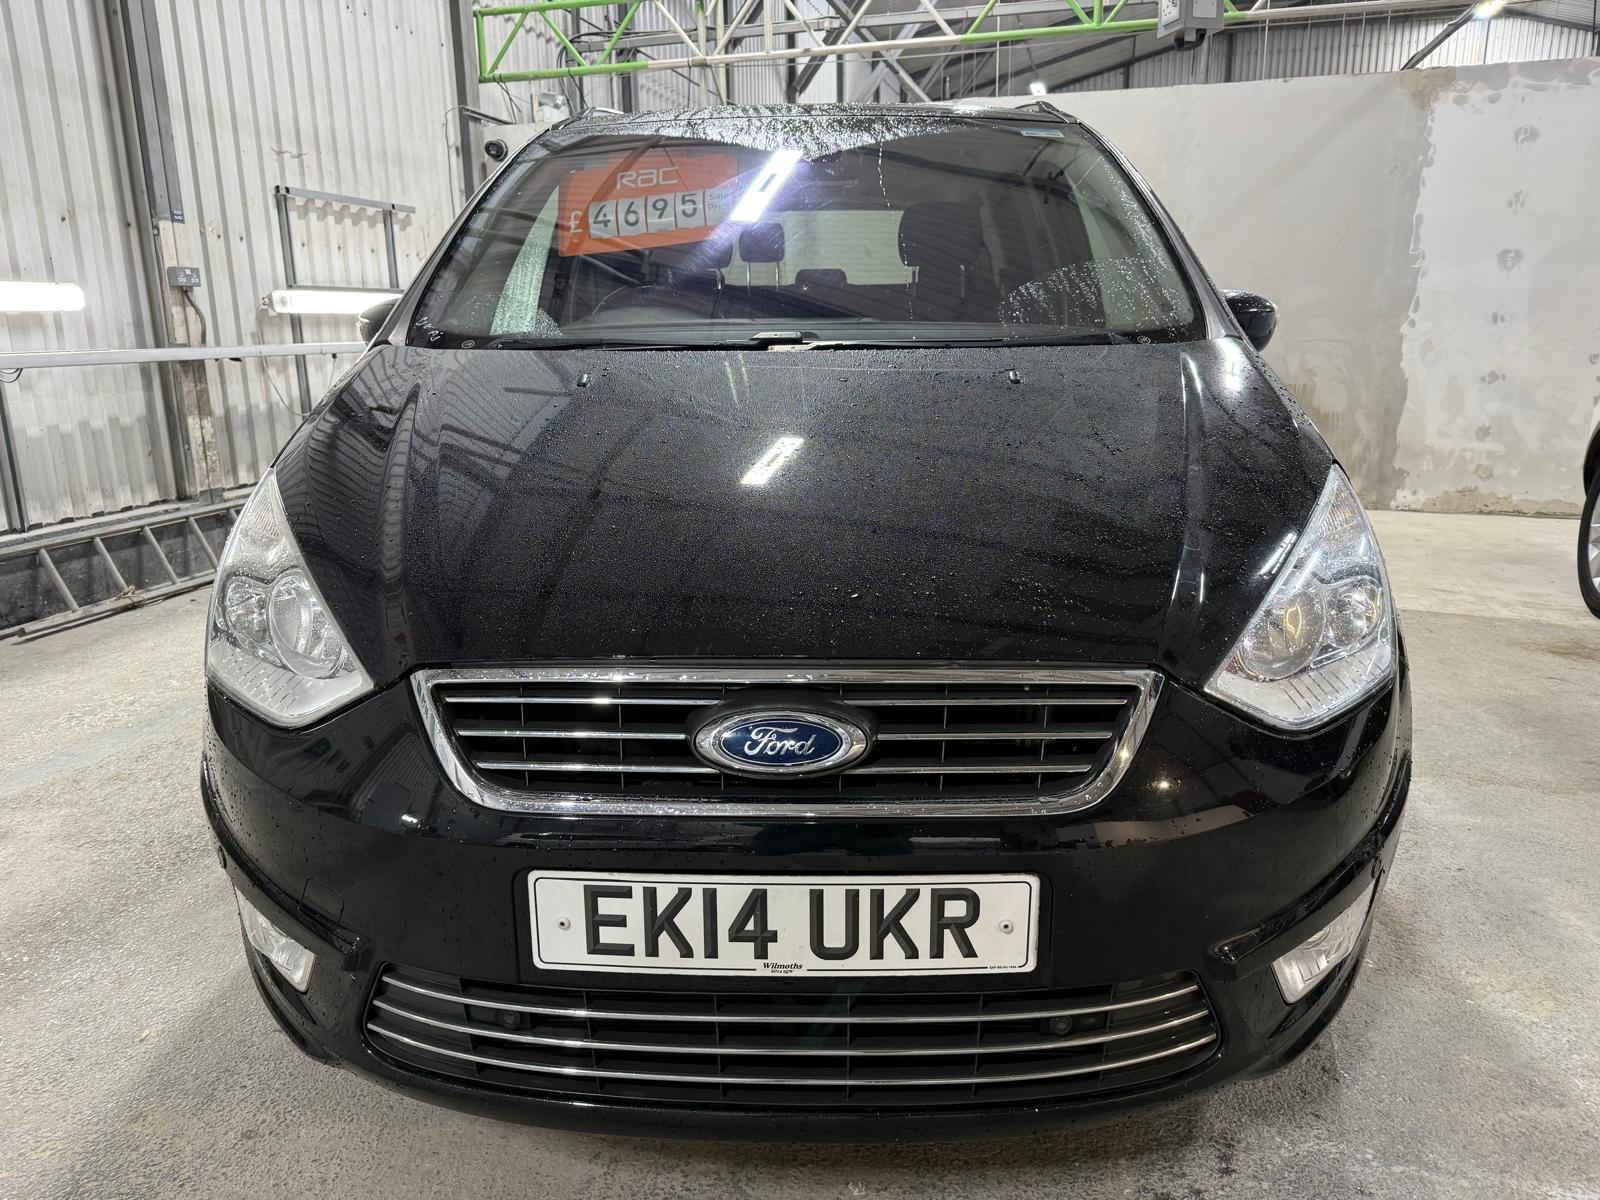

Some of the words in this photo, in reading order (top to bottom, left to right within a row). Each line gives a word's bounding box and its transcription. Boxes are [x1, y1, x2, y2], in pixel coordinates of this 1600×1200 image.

[743, 726, 817, 756] Ford
[583, 884, 778, 960] EK14
[809, 888, 981, 961] UKR
[763, 962, 803, 970] Wilmoths
